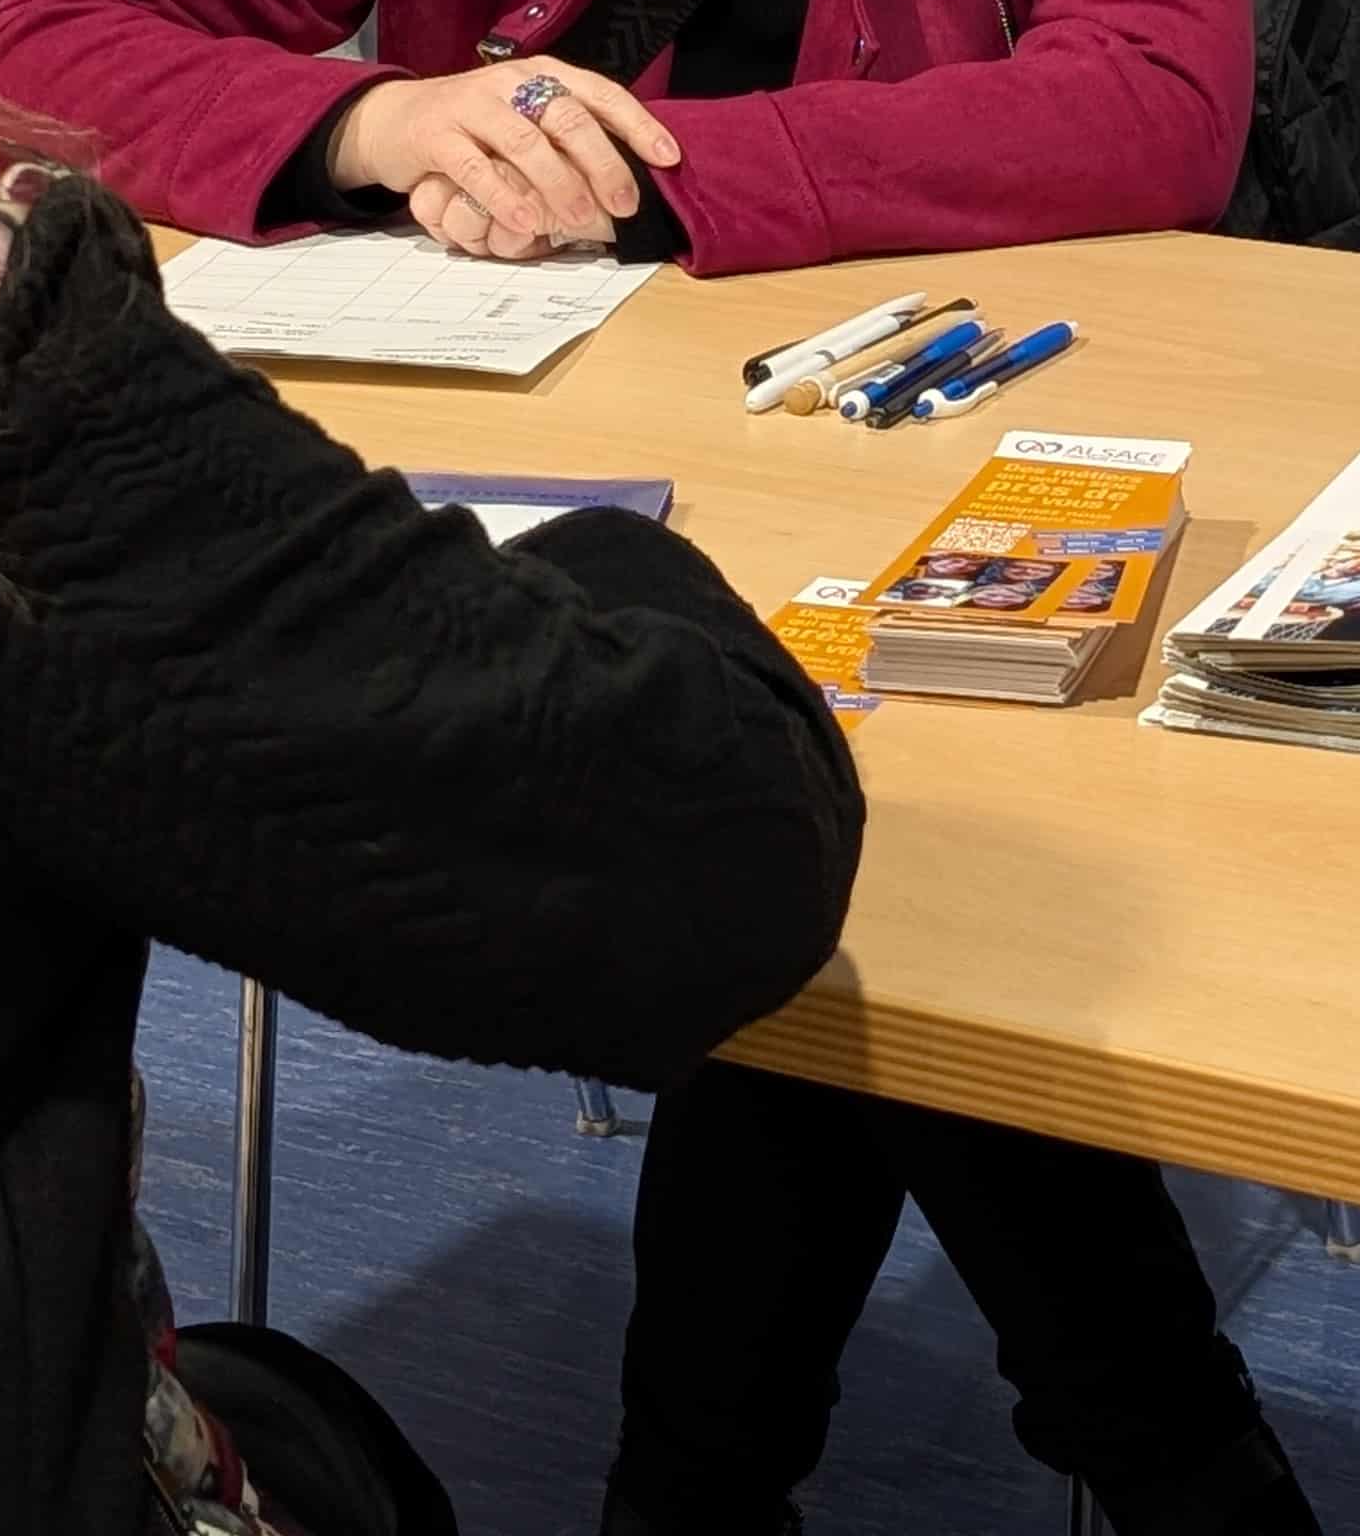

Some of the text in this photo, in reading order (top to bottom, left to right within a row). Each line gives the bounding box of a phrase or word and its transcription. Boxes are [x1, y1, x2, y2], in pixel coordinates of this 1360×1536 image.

[984, 479, 1130, 502] près de
[1041, 496, 1105, 510] vous
